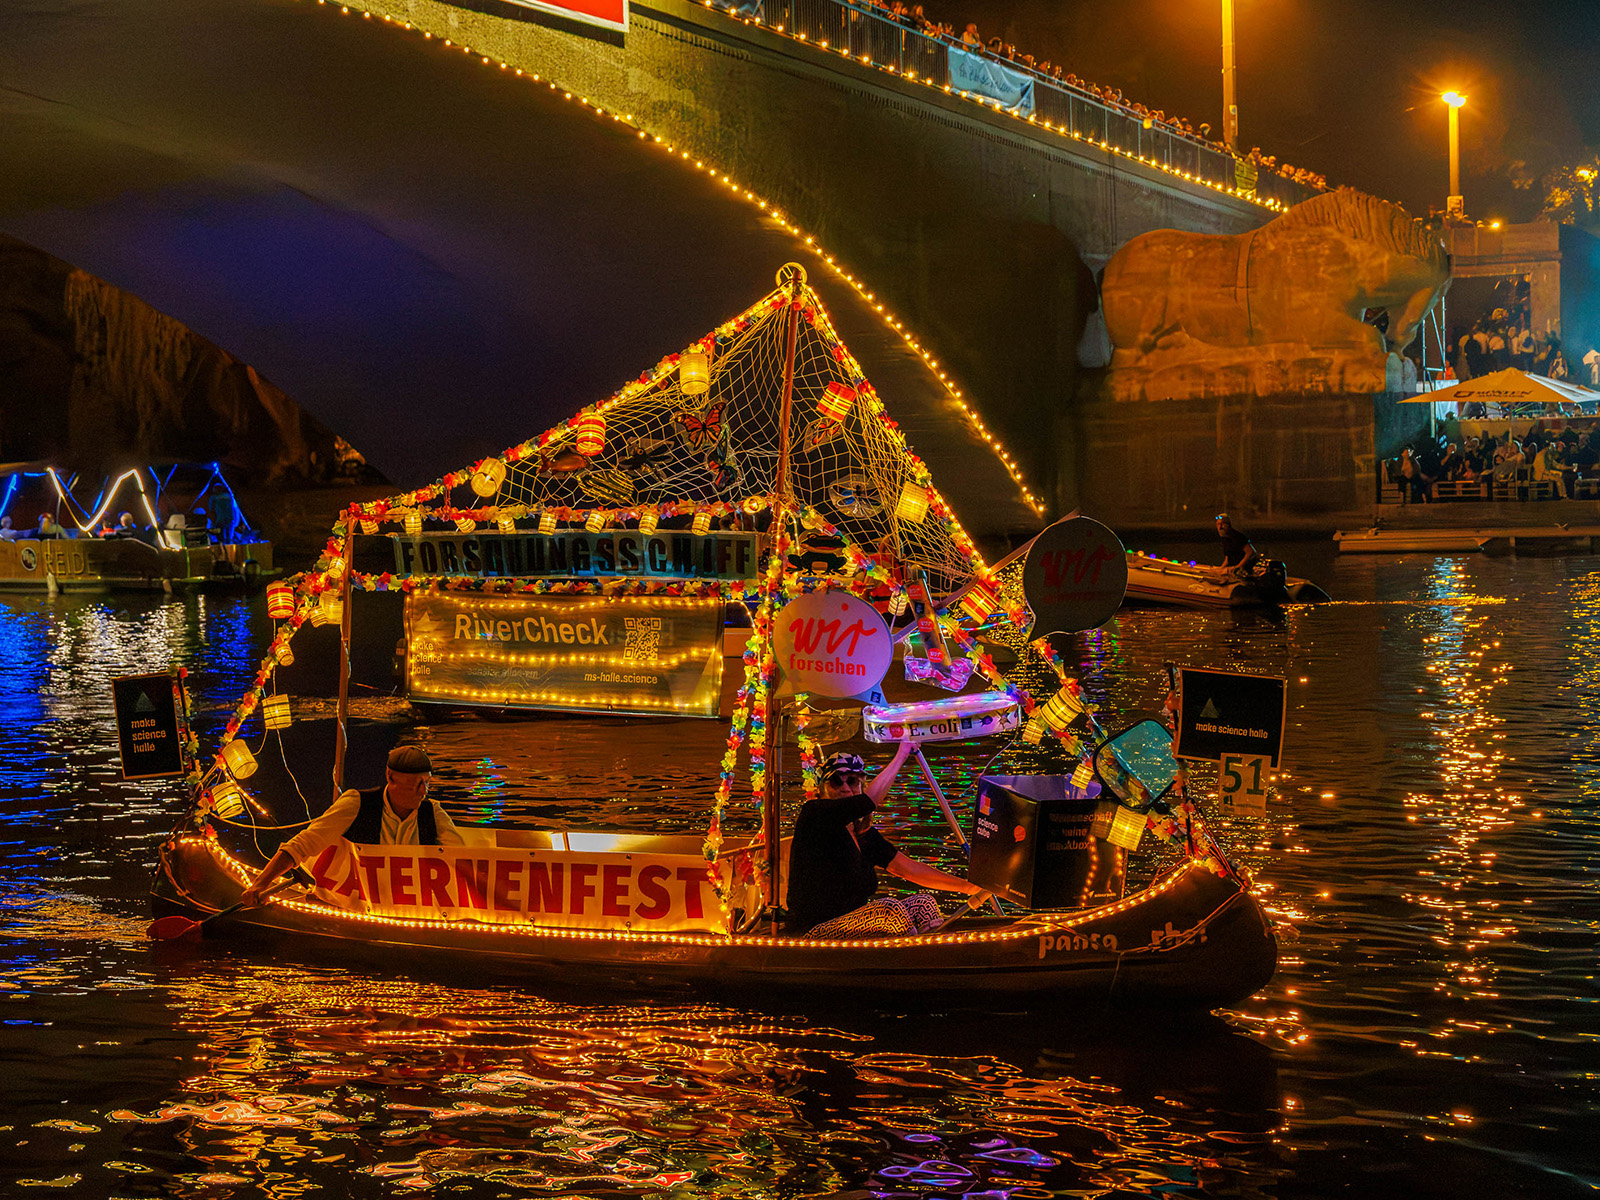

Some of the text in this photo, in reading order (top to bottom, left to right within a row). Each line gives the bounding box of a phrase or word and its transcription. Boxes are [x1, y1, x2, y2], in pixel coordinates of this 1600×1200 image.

[454, 612, 609, 645] RiverCheck
[789, 603, 877, 657] wir
[789, 653, 866, 676] forschen
[584, 671, 658, 684] ms-halle.science
[131, 718, 156, 729] make
[929, 718, 959, 735] coli
[1195, 722, 1269, 739] make science halle
[131, 730, 167, 741] science
[133, 742, 156, 753] halle
[1222, 756, 1265, 796] 51
[976, 826, 991, 839] cube
[977, 817, 999, 832] science
[311, 844, 710, 920] LATERNENFEST
